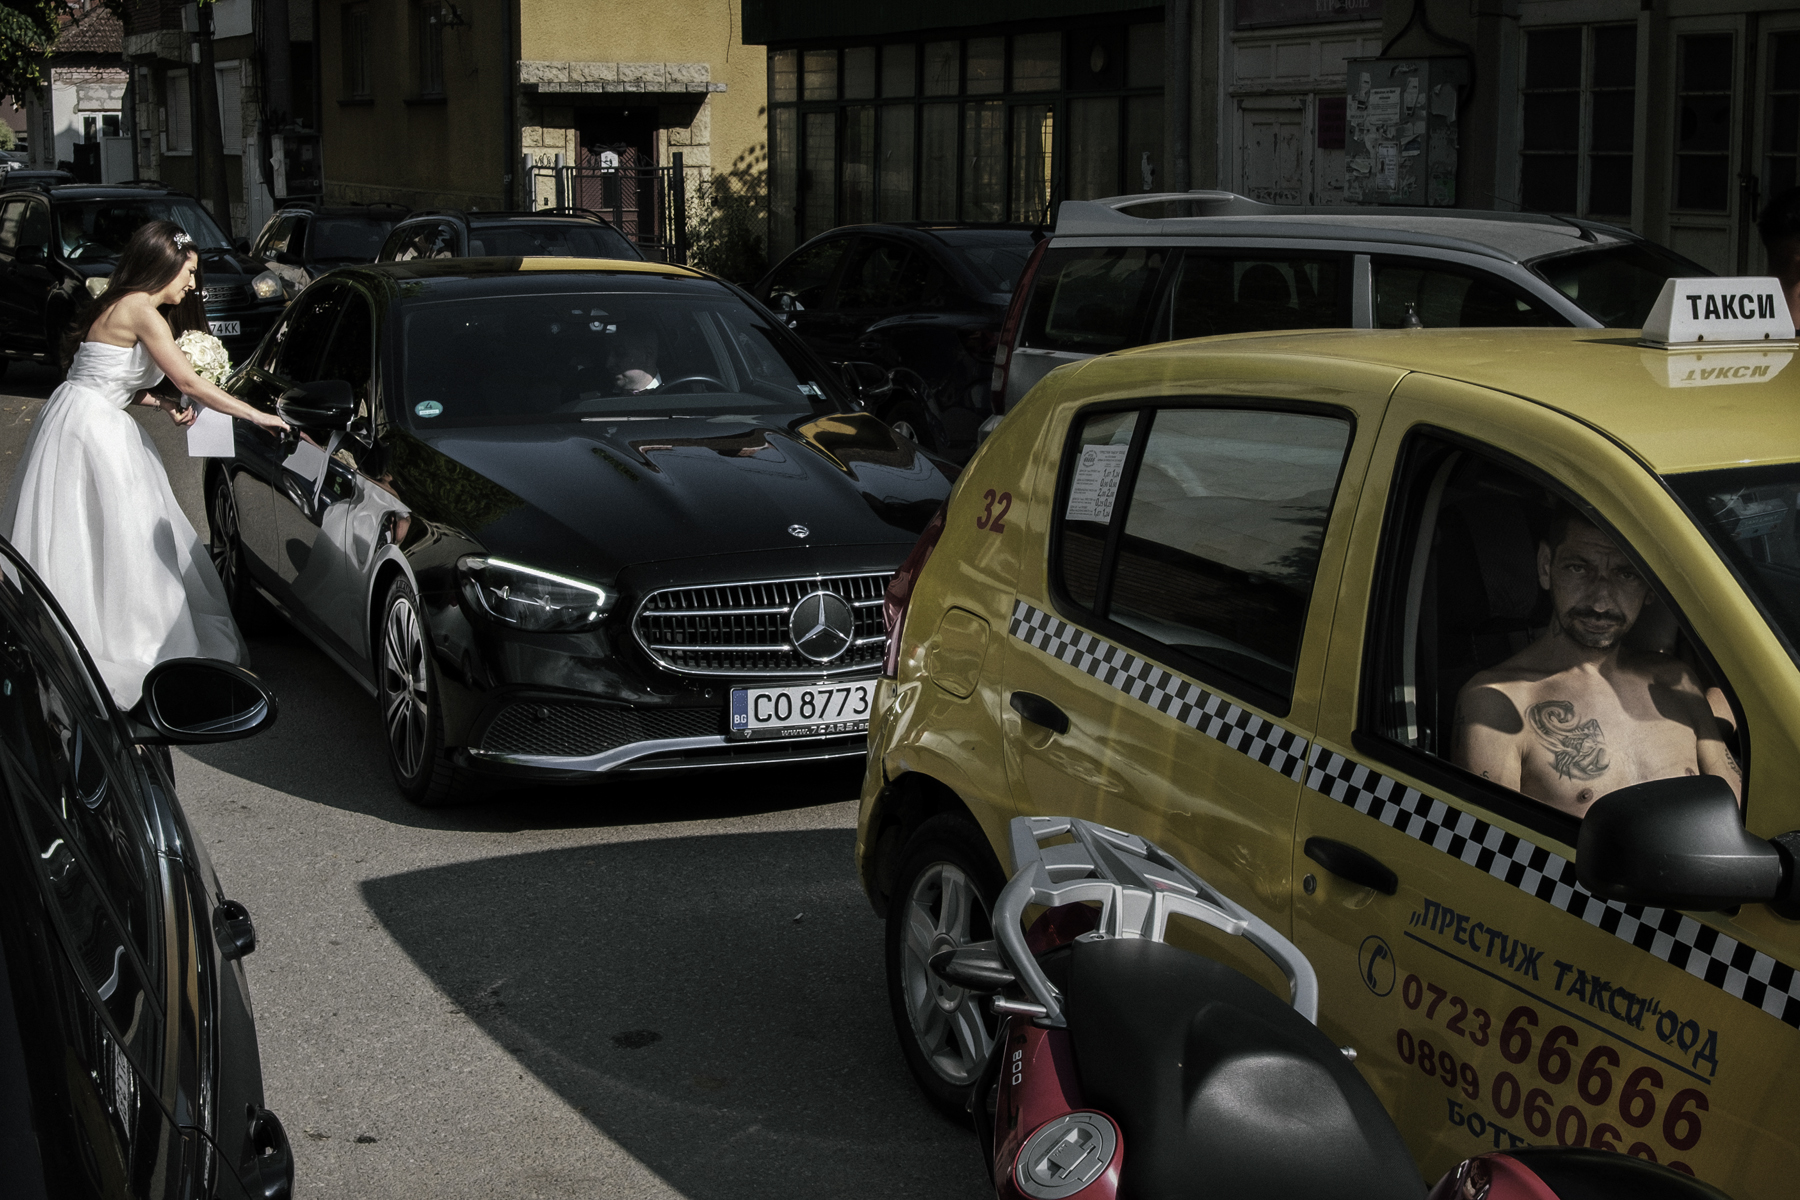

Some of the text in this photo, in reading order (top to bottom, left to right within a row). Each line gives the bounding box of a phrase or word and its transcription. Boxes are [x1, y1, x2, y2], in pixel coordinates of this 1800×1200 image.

[1686, 294, 1775, 320] ТАКСИ
[976, 488, 1012, 534] 32
[734, 714, 747, 724] BG
[754, 686, 869, 723] CO 8773
[1012, 1049, 1022, 1085] 800
[1396, 1028, 1479, 1100] 0899
[1402, 974, 1709, 1151] 0723 66666
